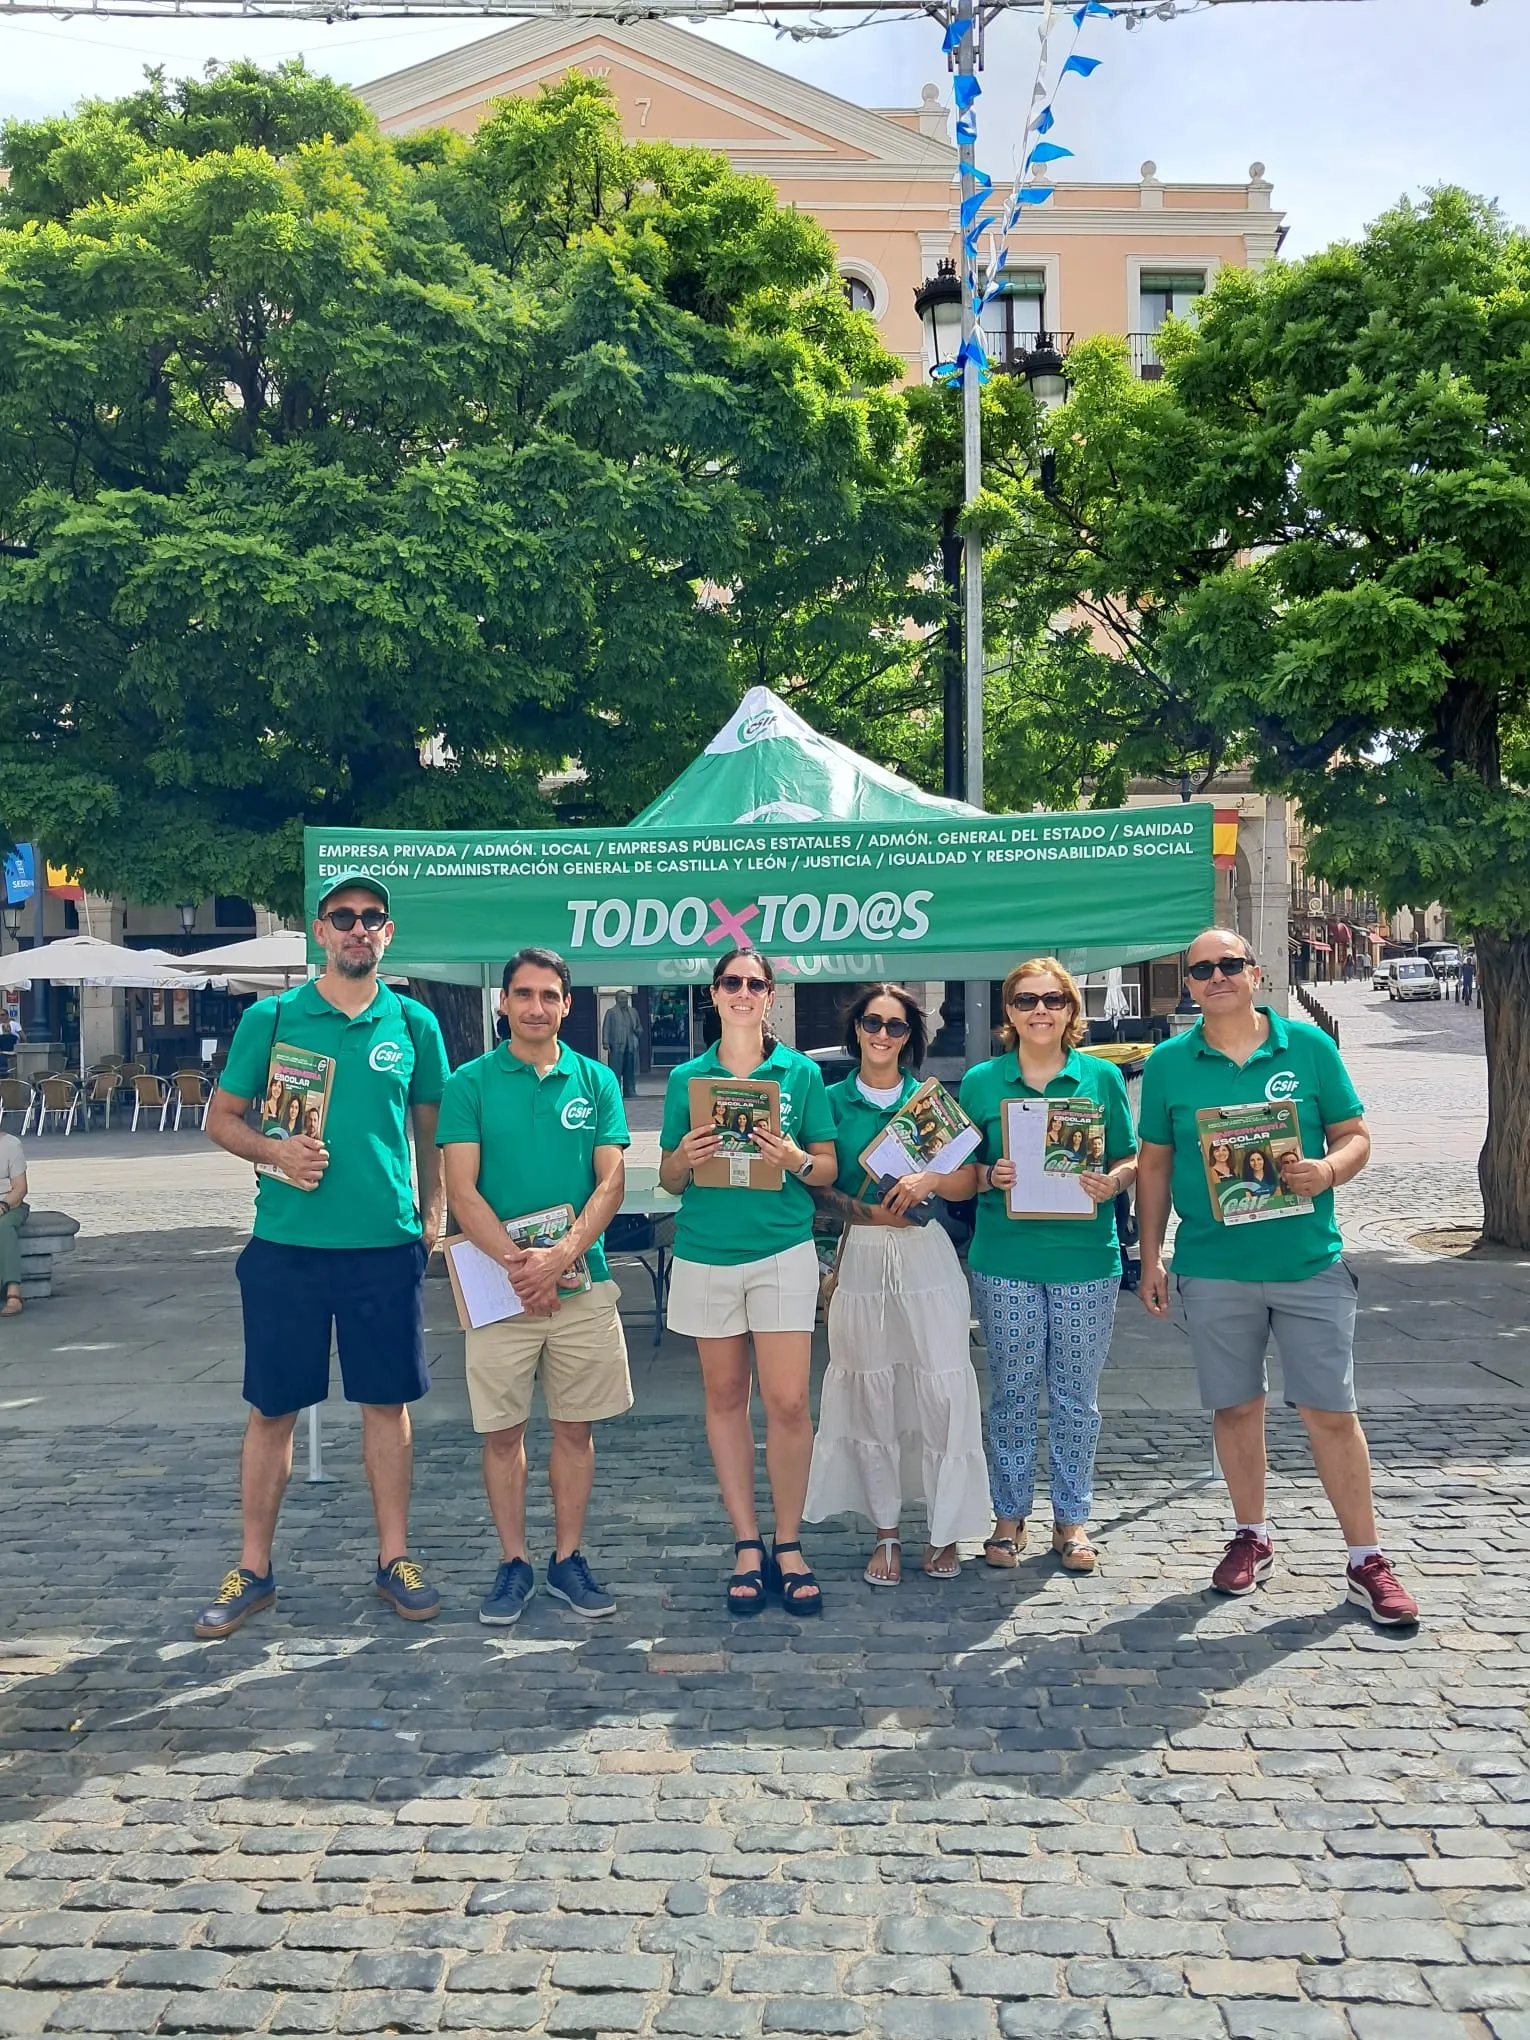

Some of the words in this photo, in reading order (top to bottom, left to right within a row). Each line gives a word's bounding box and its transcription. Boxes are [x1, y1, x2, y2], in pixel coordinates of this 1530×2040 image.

[318, 844, 389, 857] EMPRESA
[394, 844, 457, 857] PRIVADA
[473, 840, 537, 856] ADMÓN.
[541, 843, 591, 856] LOCAL
[608, 840, 689, 855] EMPRESAS
[692, 836, 766, 852] PÚBLICAS
[770, 835, 851, 850] ESTATALES
[868, 830, 932, 847] ADMÓN.
[937, 830, 1007, 845] GENERAL
[1011, 829, 1038, 842] DEL
[1043, 825, 1106, 841] ESTADO
[1123, 822, 1194, 837] SANIDAD
[425, 859, 559, 877] ADMINISTRACIÓN
[563, 862, 630, 875] GENERAL
[634, 860, 652, 873] DE
[656, 859, 729, 873] CASTILLA
[733, 858, 744, 871] Y
[748, 853, 787, 870] LEÓN
[803, 854, 872, 869] JUSTICIA
[888, 851, 967, 866] IGUALDAD
[971, 850, 983, 863] Y
[986, 844, 1129, 863] RESPONSABILIDAD
[1132, 842, 1194, 857] SOCIAL
[274, 1072, 311, 1088] ESCOLAR
[1212, 1132, 1270, 1147] ESCOLAR
